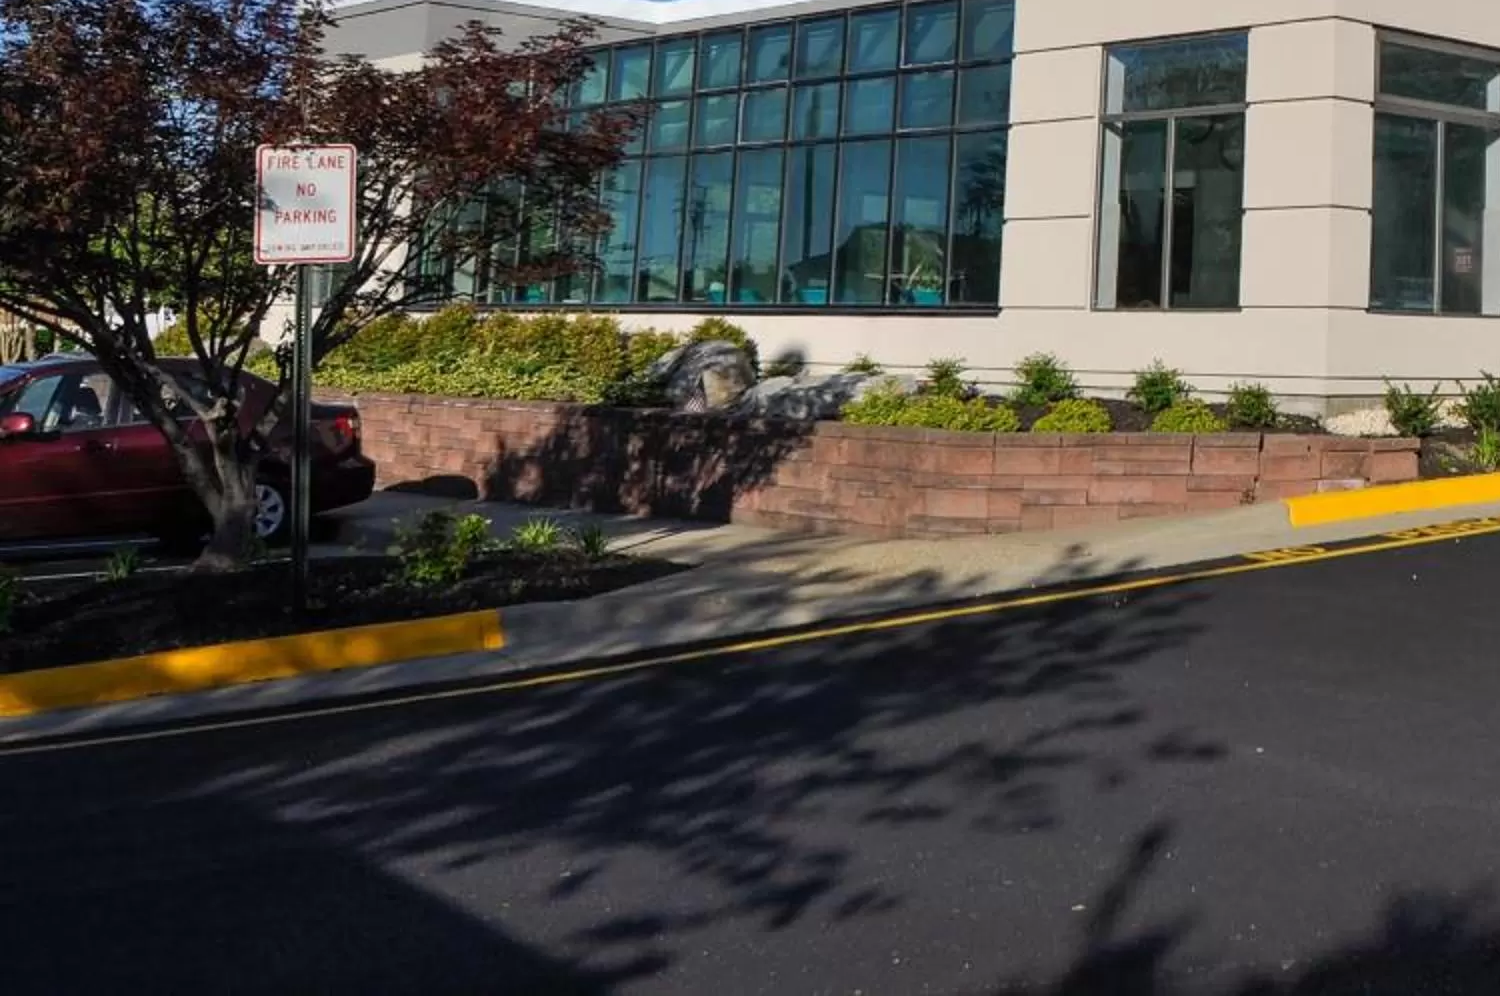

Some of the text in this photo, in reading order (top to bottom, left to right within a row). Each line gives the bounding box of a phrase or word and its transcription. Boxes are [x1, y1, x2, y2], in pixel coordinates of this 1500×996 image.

[267, 155, 345, 170] FIRE LANE
[296, 183, 317, 197] NO
[274, 209, 337, 224] PARKING
